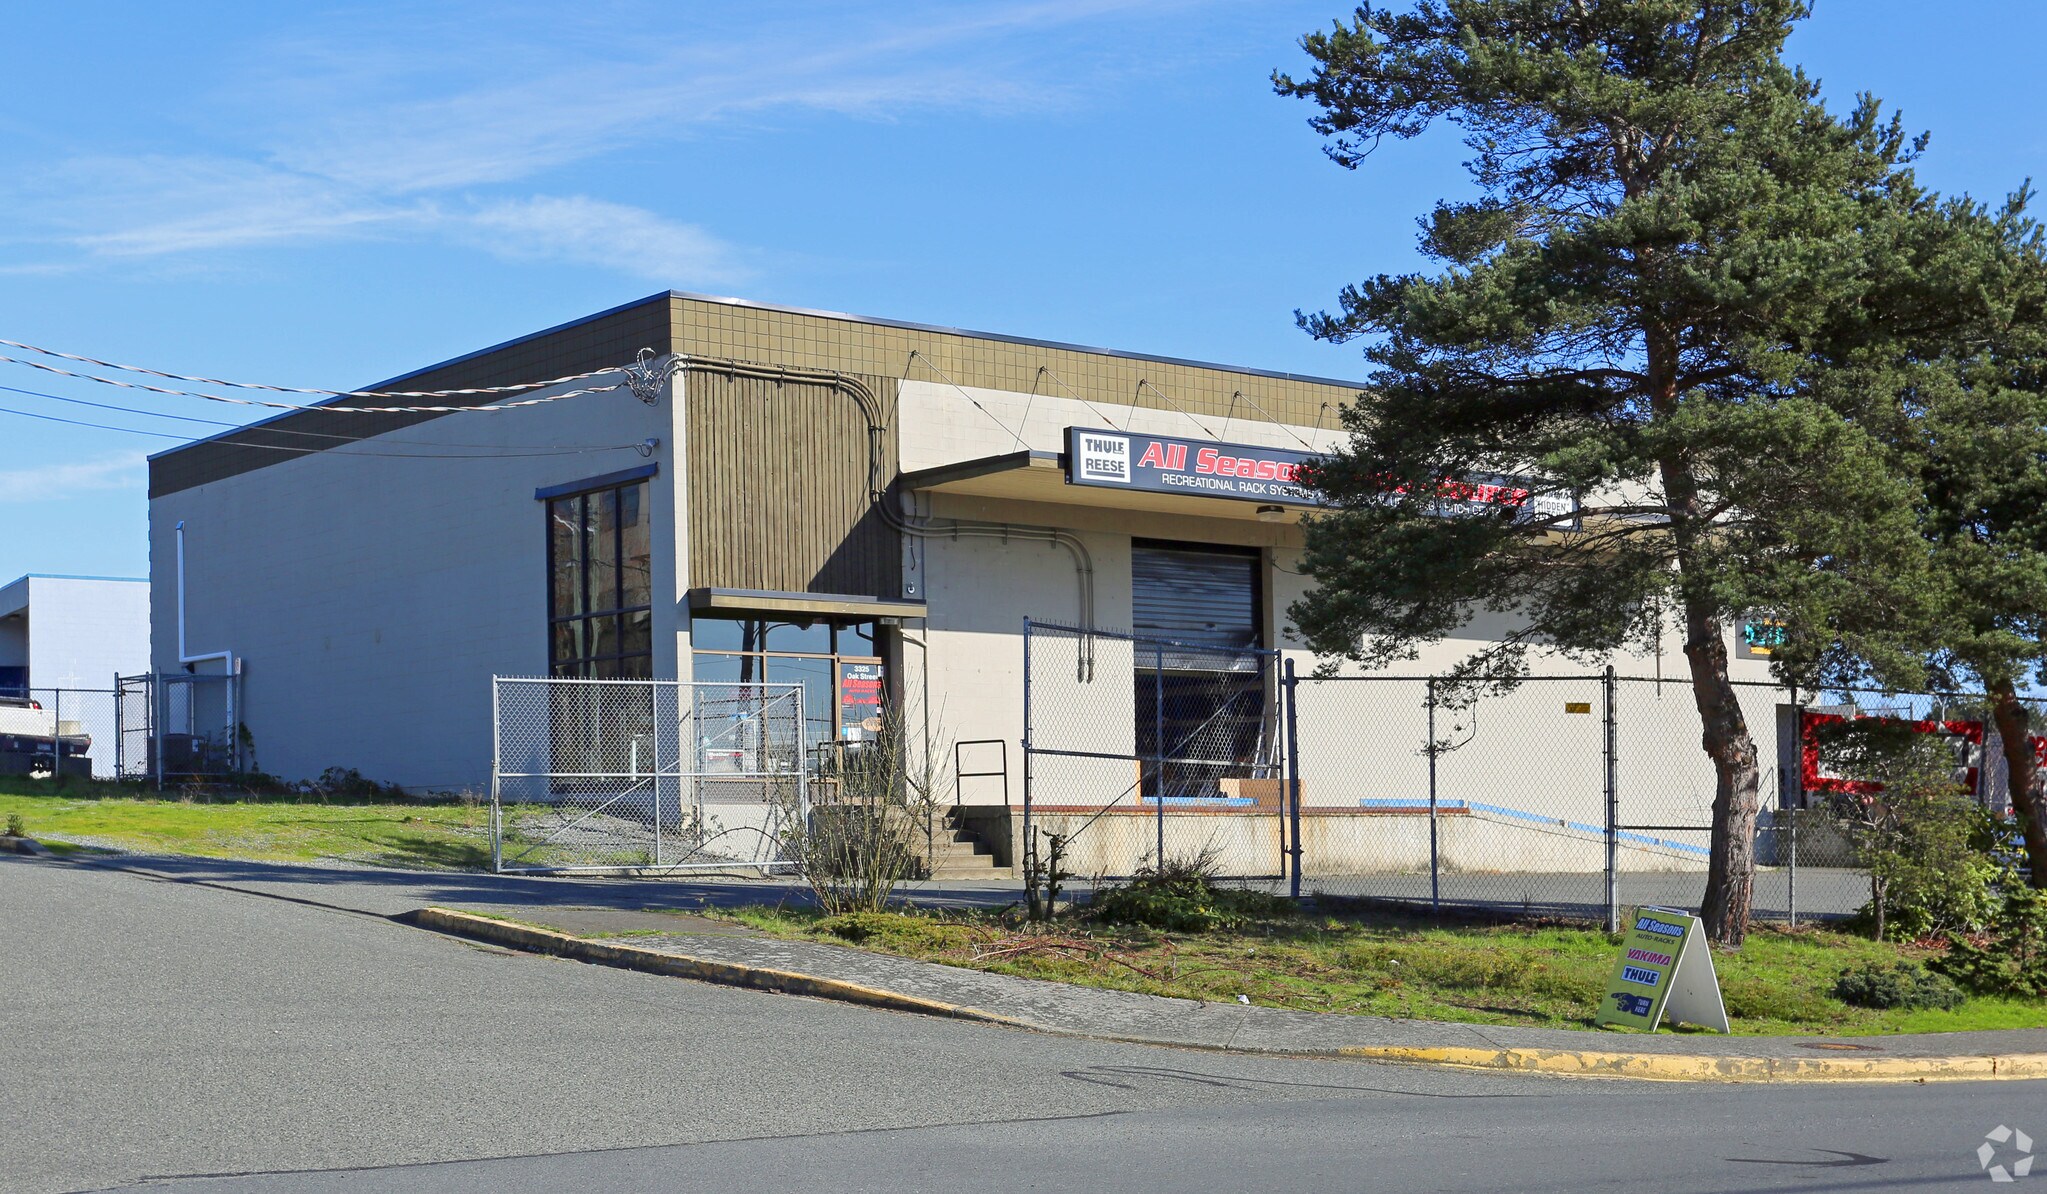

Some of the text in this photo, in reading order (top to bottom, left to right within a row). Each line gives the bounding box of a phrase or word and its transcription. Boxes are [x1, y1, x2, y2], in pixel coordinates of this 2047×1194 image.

[1085, 438, 1125, 455] THULE
[1085, 457, 1125, 473] REESE
[1137, 441, 1188, 472] All
[1196, 449, 1334, 487] Seaso
[1162, 473, 1237, 492] RECREATIONAL
[1239, 481, 1267, 494] RACK
[847, 672, 860, 680] Oak
[853, 665, 870, 673] 3325
[1635, 917, 1684, 937] All Seasons
[1626, 947, 1672, 966] YAKIMA
[1624, 967, 1658, 984] THULE
